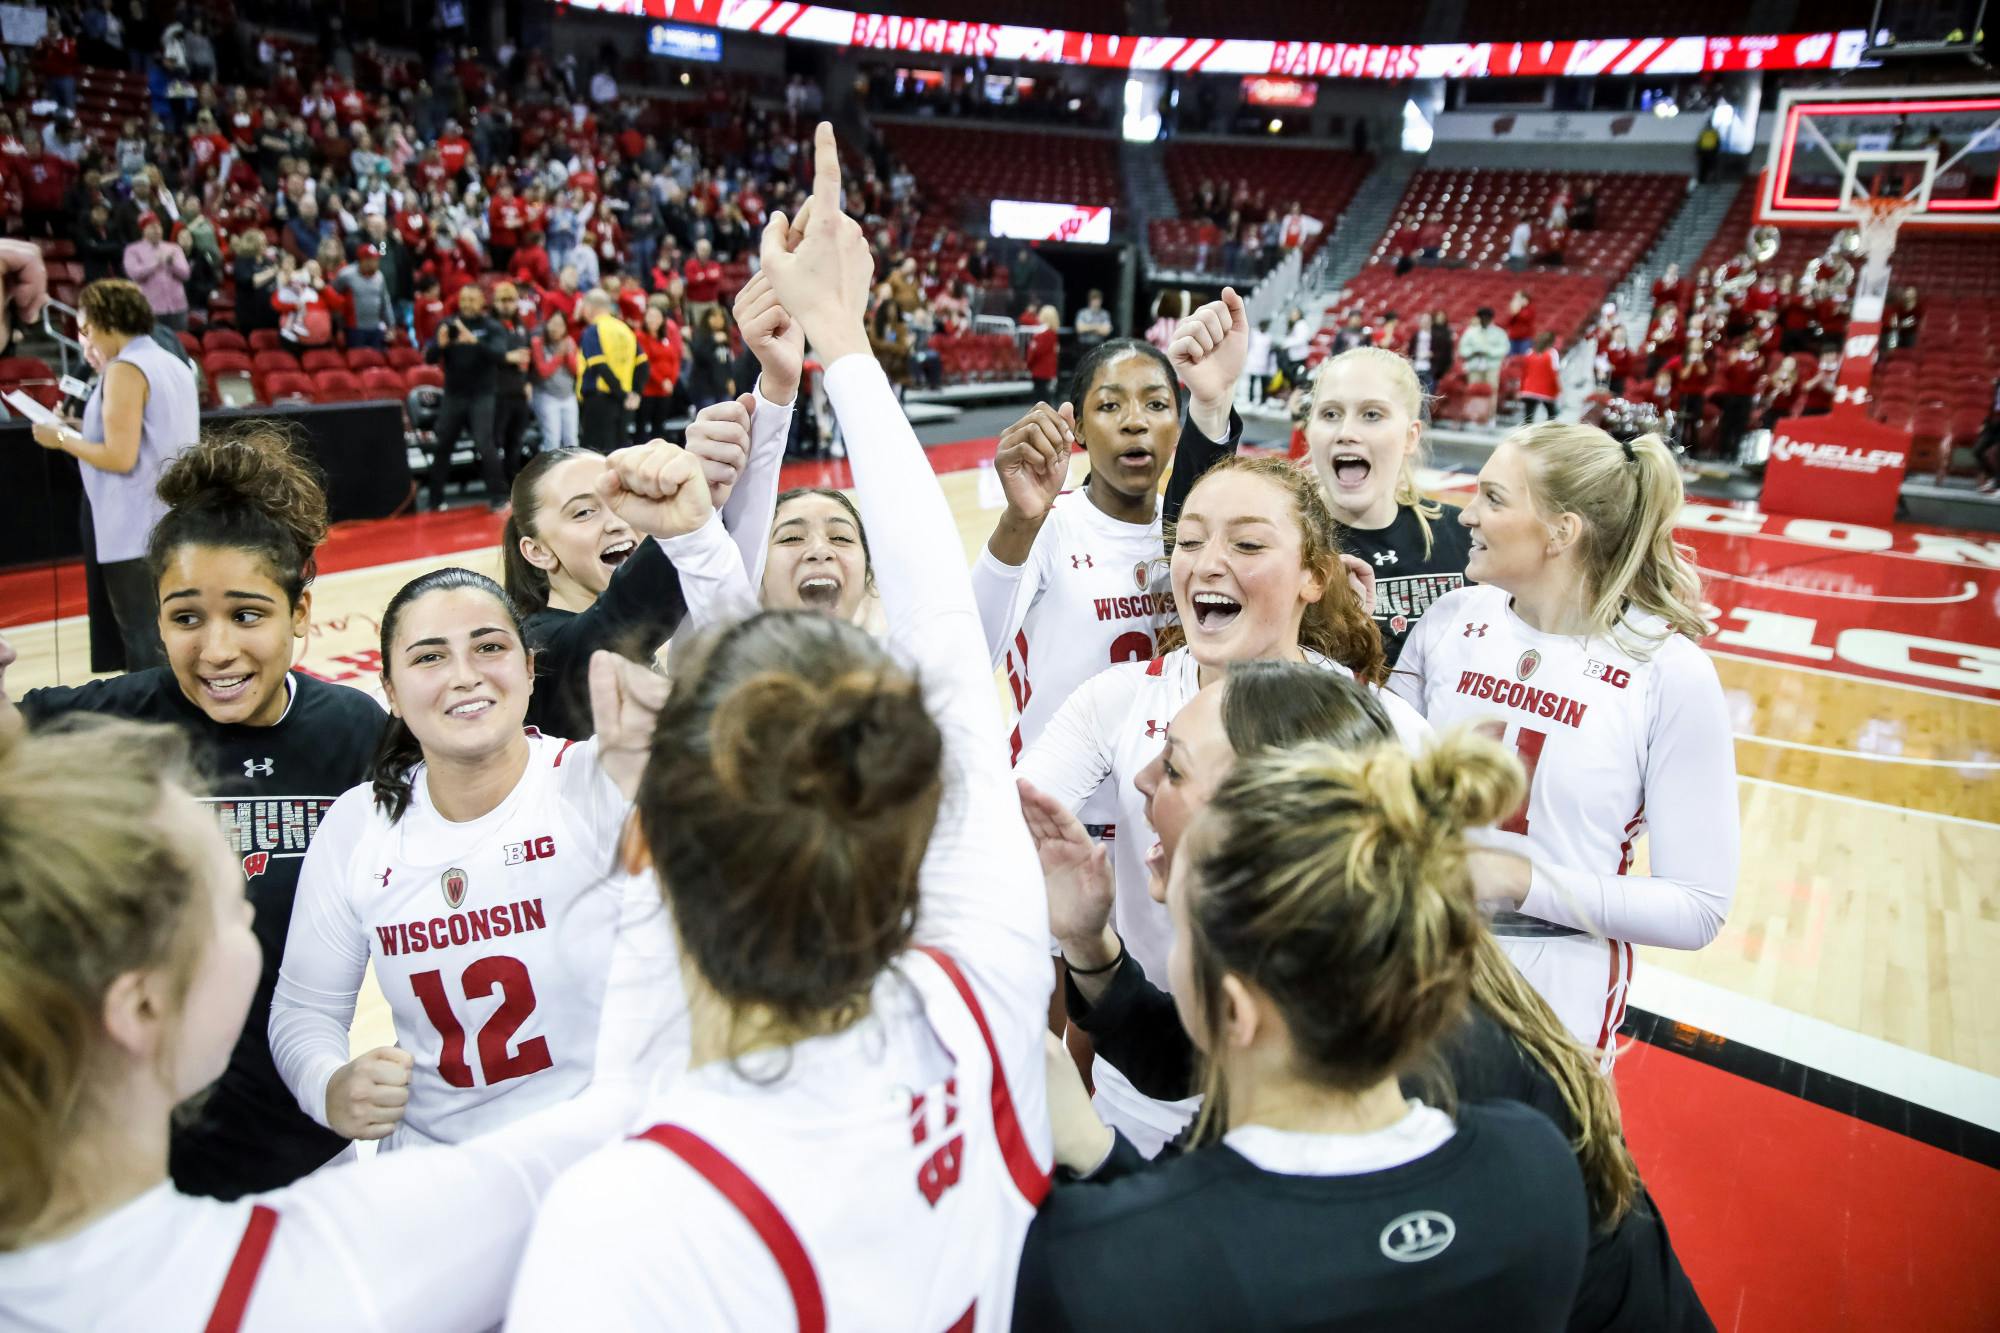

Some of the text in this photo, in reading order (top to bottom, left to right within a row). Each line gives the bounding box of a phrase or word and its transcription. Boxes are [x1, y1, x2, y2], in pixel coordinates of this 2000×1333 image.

[852, 13, 1002, 57] BADGERS
[1269, 40, 1424, 78] BADGERS
[1787, 440, 1904, 468] MUELLER
[1456, 671, 1588, 729] WISCONSIN
[376, 898, 546, 956] WISCONSIN
[409, 955, 553, 1088] 12
